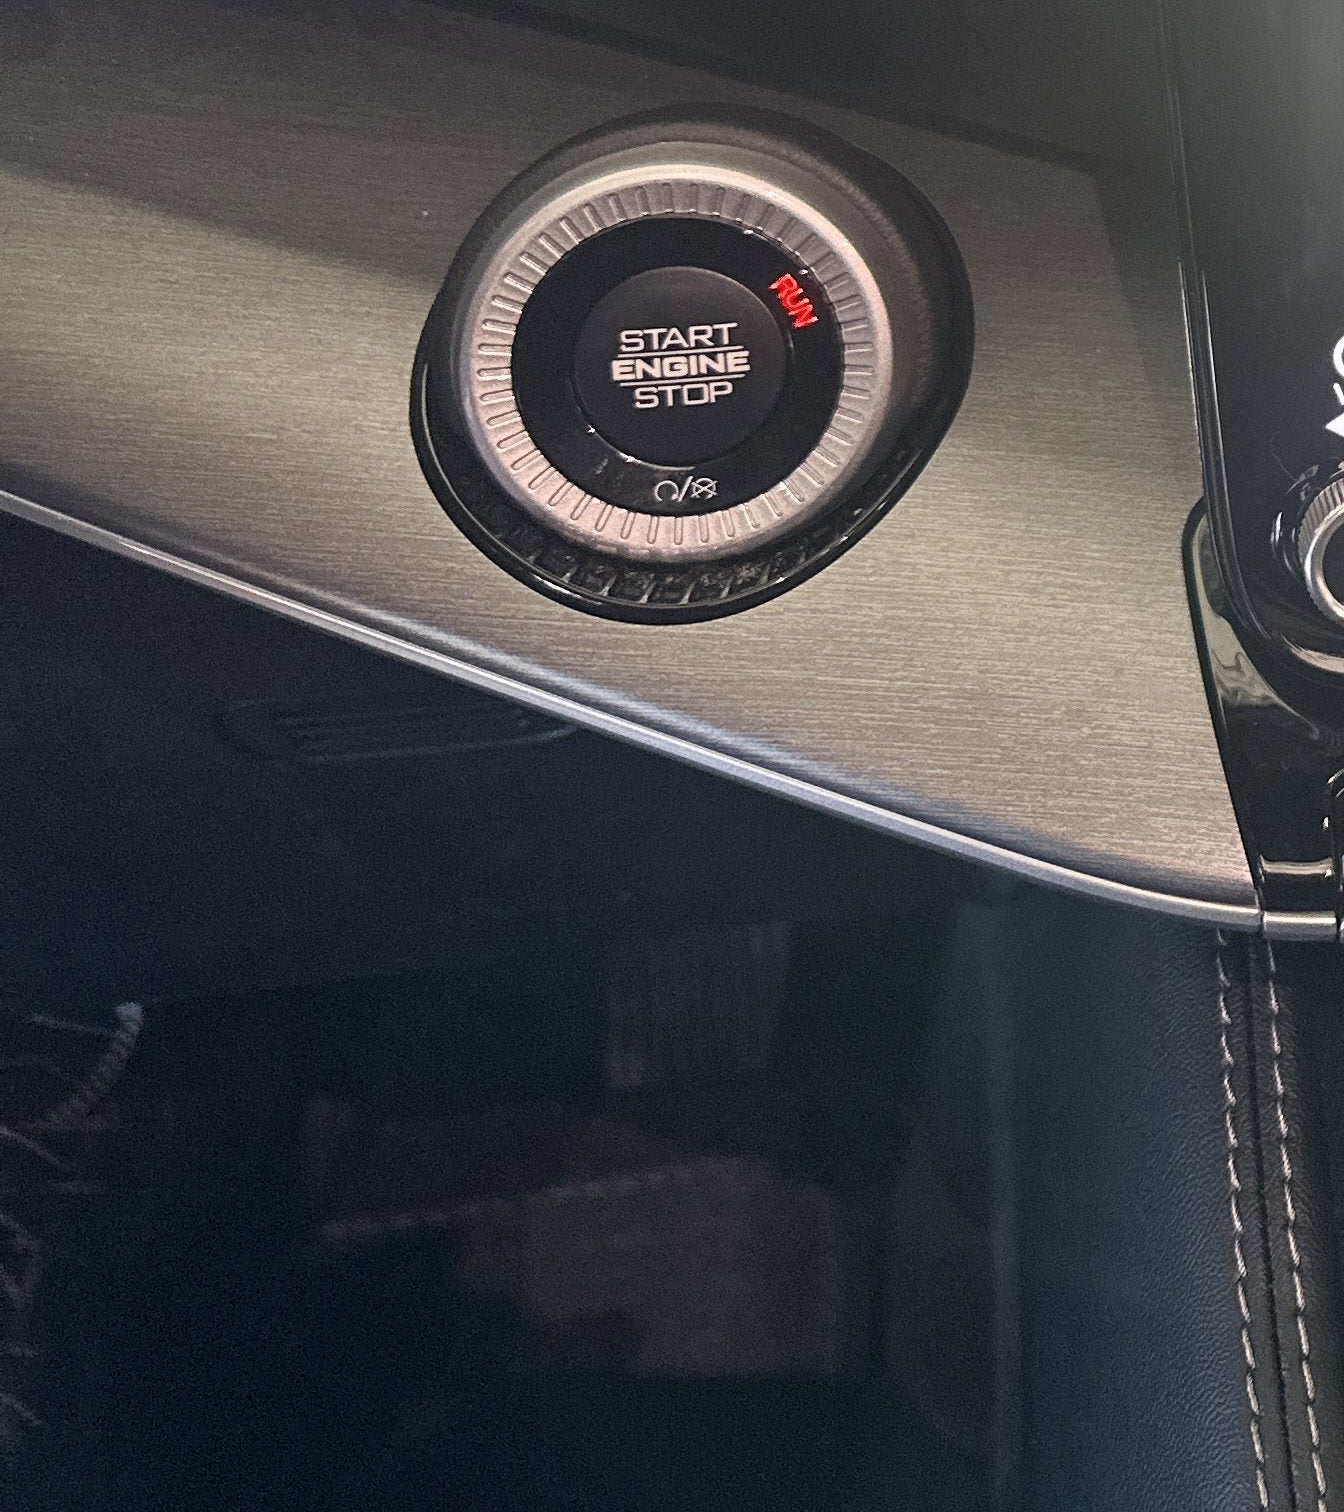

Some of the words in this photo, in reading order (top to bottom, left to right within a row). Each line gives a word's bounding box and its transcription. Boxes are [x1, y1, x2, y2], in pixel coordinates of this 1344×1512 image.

[769, 274, 818, 328] RUN
[619, 323, 738, 352] START
[612, 351, 751, 381] ENGINE
[634, 381, 733, 409] STOP
